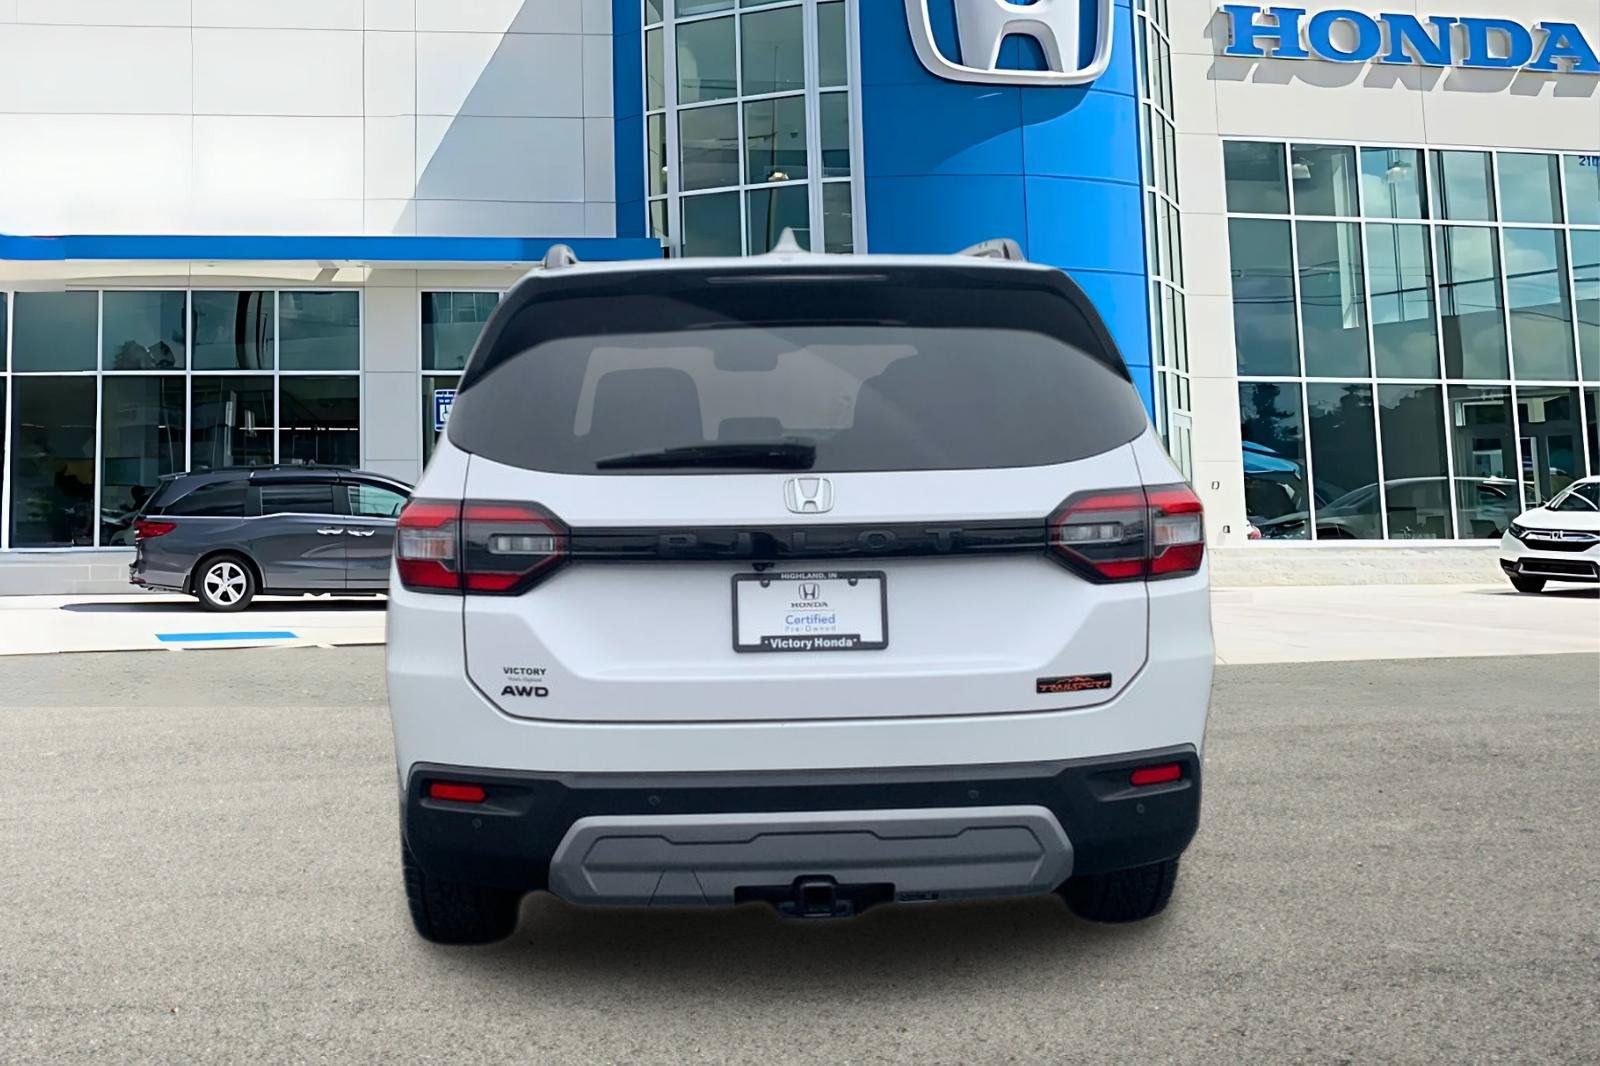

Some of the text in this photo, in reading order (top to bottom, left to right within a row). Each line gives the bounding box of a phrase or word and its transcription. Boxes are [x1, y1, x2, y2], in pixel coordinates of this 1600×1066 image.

[1222, 4, 1600, 73] HONDA
[658, 527, 962, 554] PILOT
[791, 601, 829, 609] HONDA
[785, 613, 836, 625] Certified
[770, 636, 853, 650] Victory Honda
[503, 667, 547, 676] VICTORY
[501, 685, 549, 698] AWD
